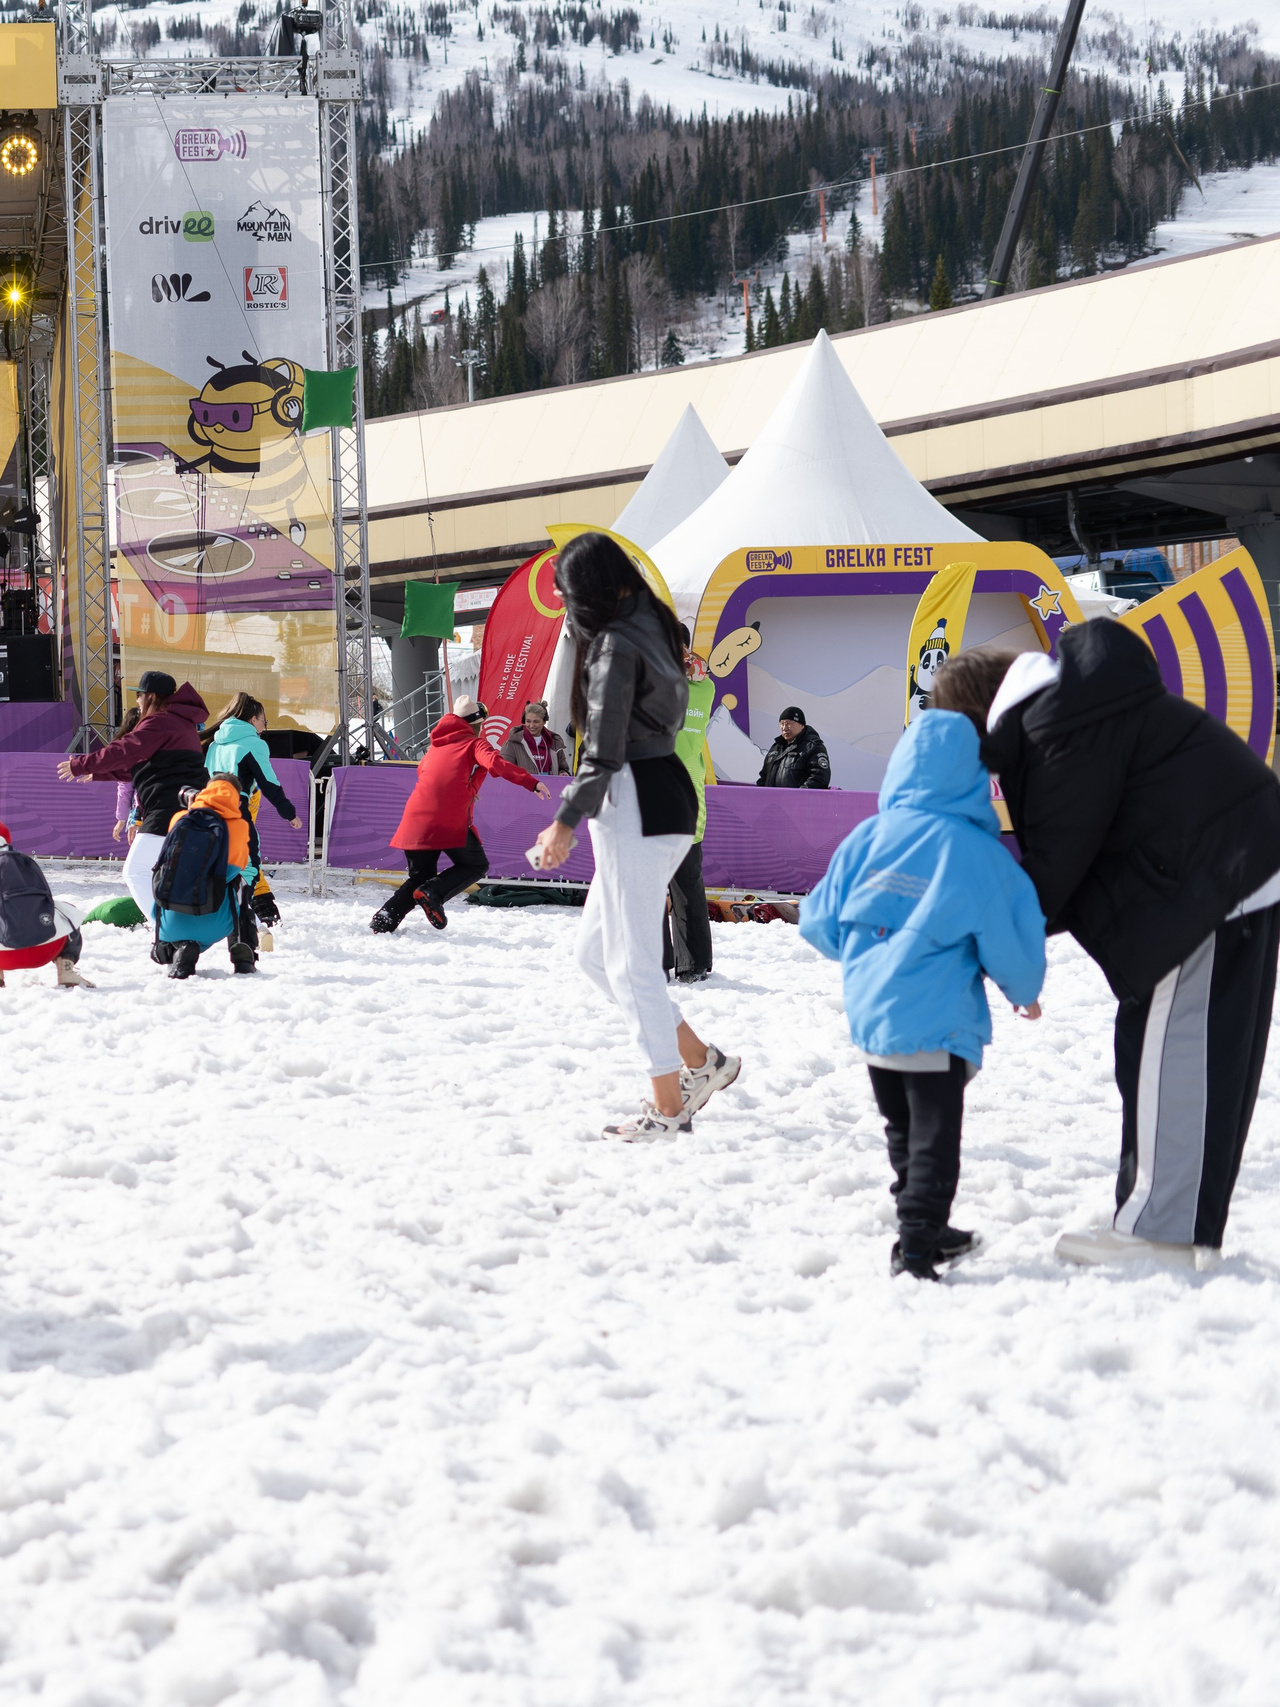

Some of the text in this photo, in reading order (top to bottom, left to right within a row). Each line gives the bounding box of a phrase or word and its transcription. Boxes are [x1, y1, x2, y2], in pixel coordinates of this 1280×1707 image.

[181, 133, 216, 145] GRELKA
[182, 146, 206, 157] FEST
[139, 216, 214, 236] drivee
[237, 221, 291, 232] MOUNTAIN
[267, 232, 292, 242] MAN
[750, 553, 773, 561] GRELKA
[825, 547, 934, 568] GRELKA FEST
[750, 561, 766, 569] FEST
[504, 653, 516, 674] RIDE
[506, 634, 534, 700] MUSIC FESTIVAL
